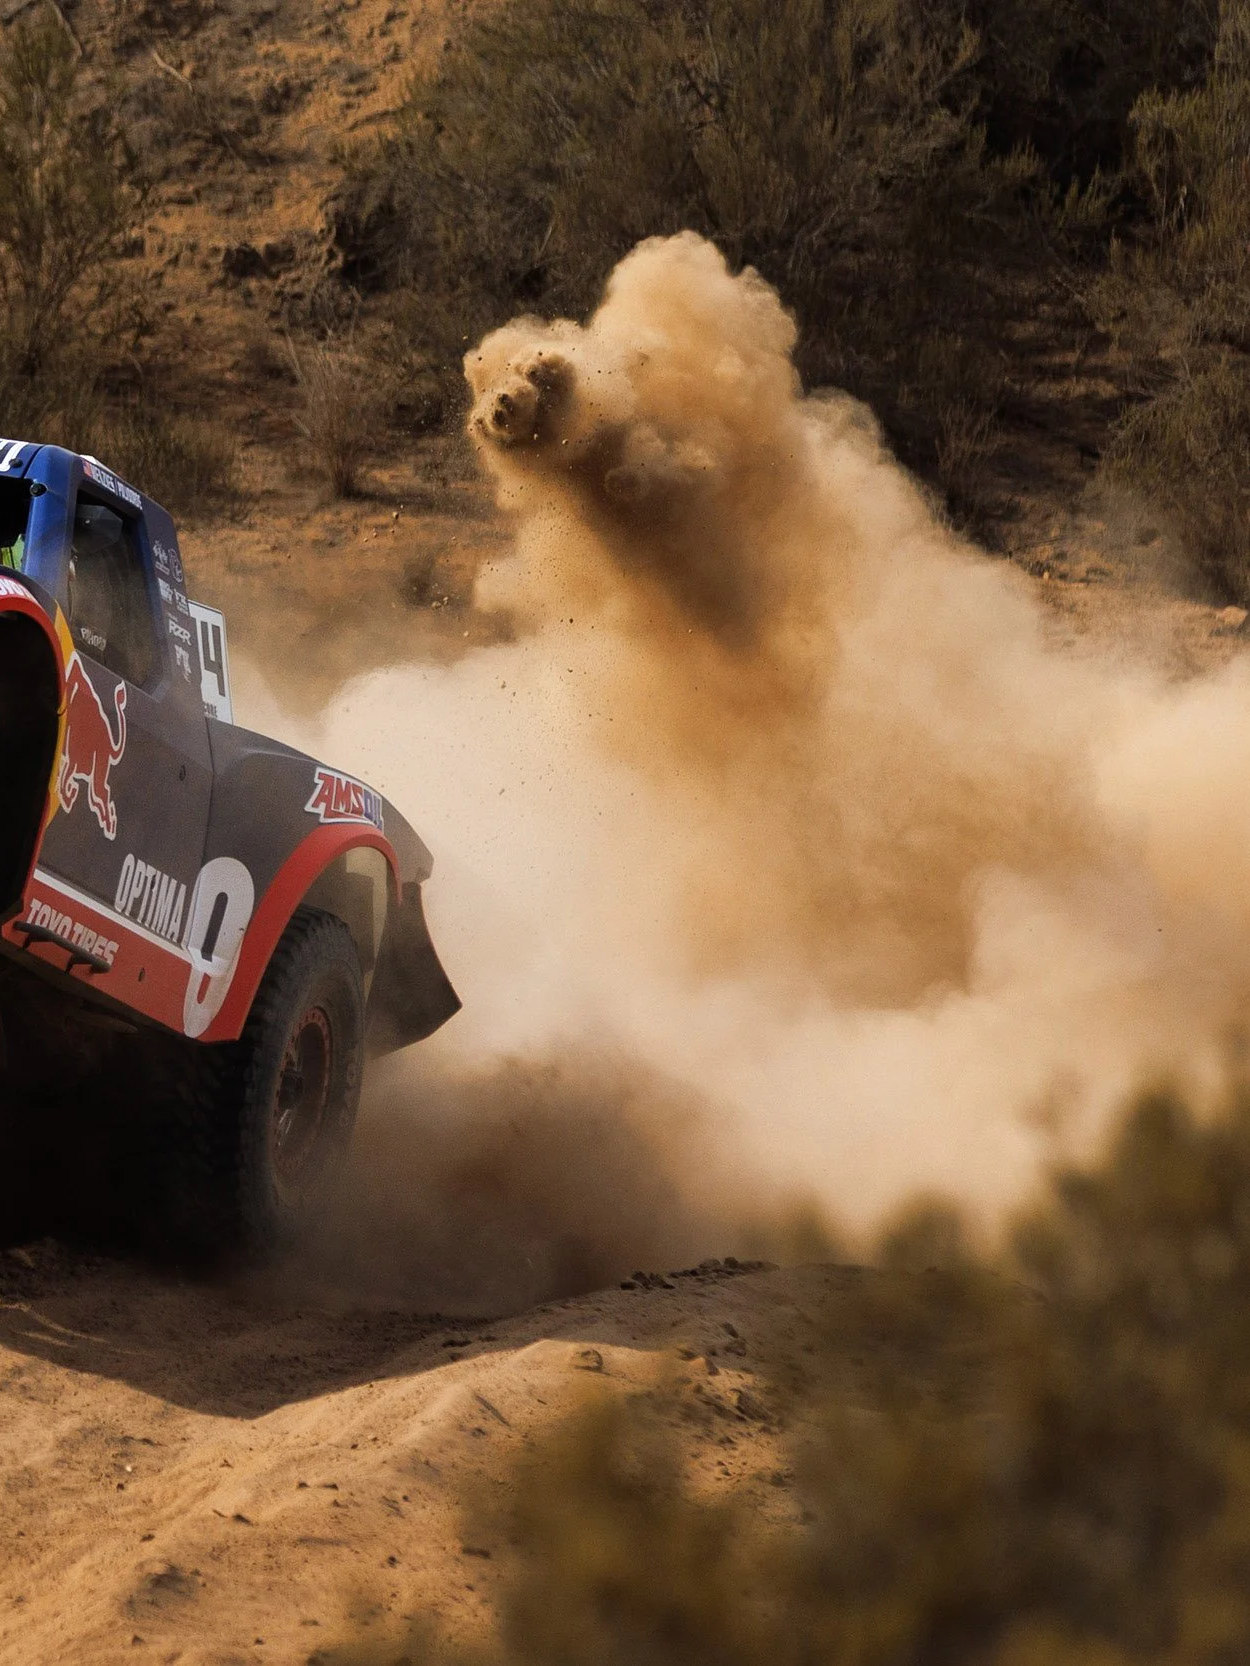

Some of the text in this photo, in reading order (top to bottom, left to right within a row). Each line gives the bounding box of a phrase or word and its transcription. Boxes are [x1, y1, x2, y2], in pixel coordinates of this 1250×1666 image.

[308, 769, 384, 832] AMSOIL
[30, 897, 120, 966] TOYO TIRES
[114, 853, 187, 943] OPTIMA
